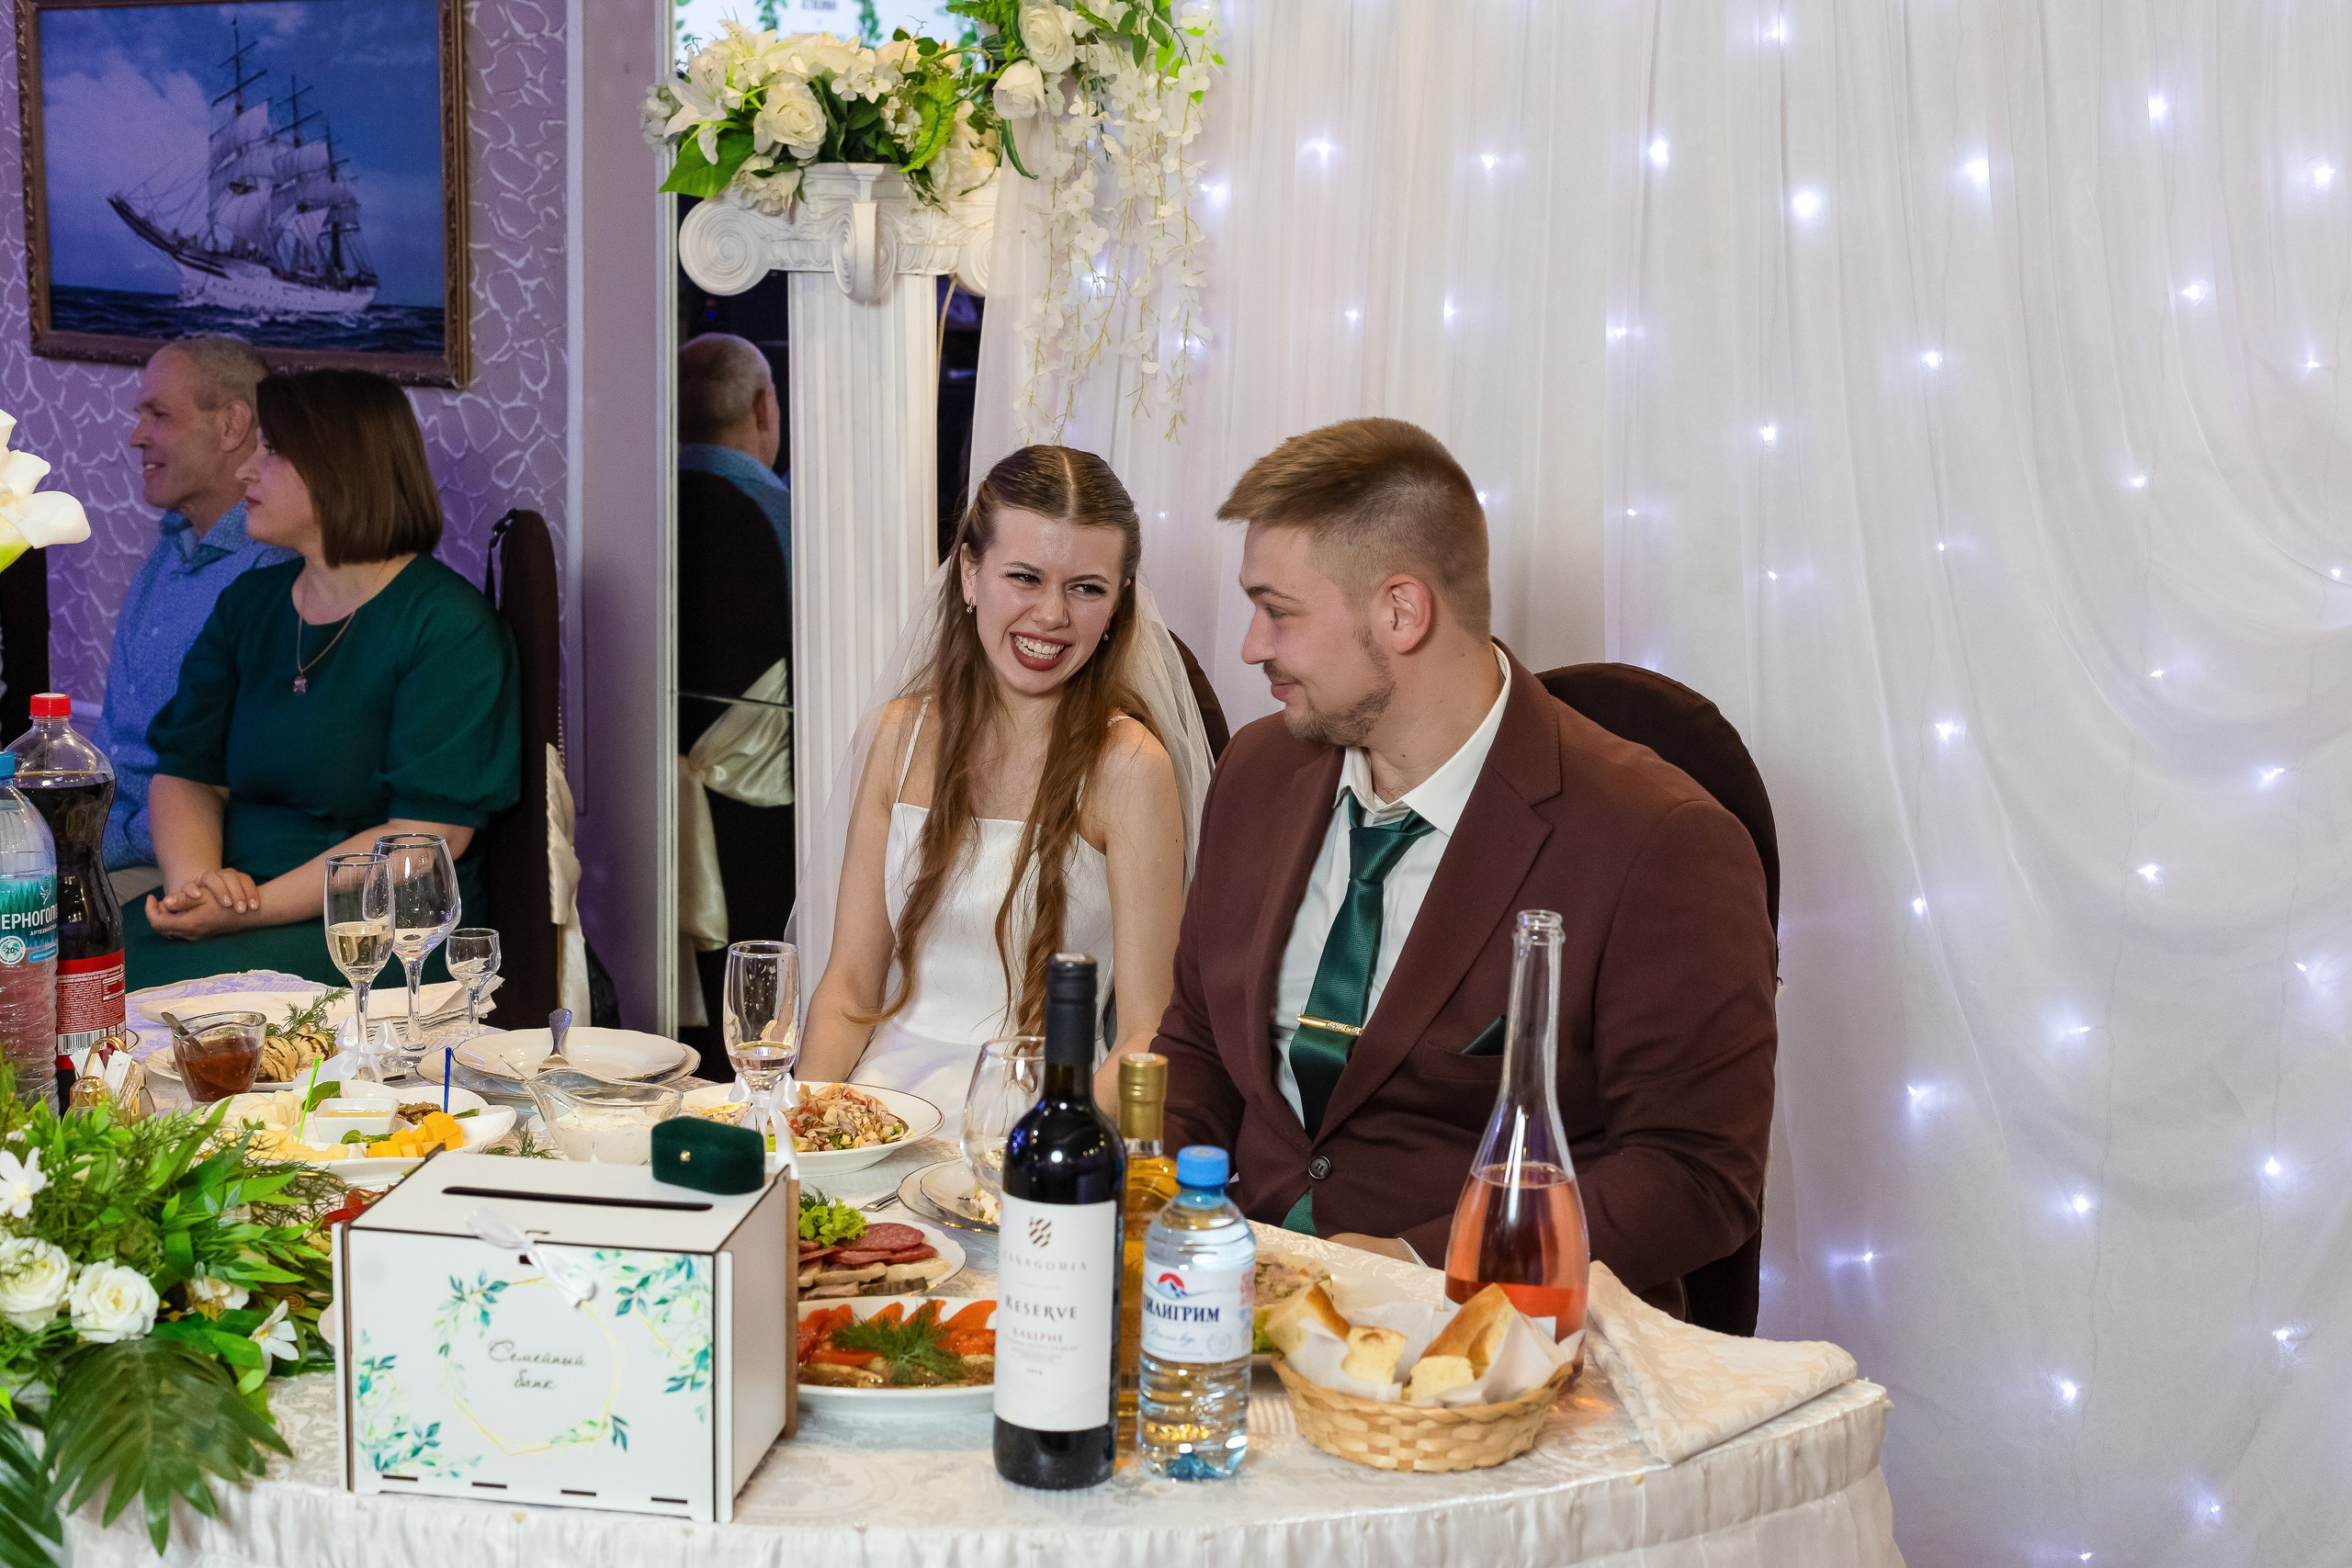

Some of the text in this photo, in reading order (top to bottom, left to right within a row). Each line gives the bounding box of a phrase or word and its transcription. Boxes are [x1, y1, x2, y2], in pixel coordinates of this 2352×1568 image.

[0, 904, 58, 931] ЕРНОГОЛ
[1005, 1294, 1078, 1321] RESERVE
[514, 1369, 556, 1390] банк
